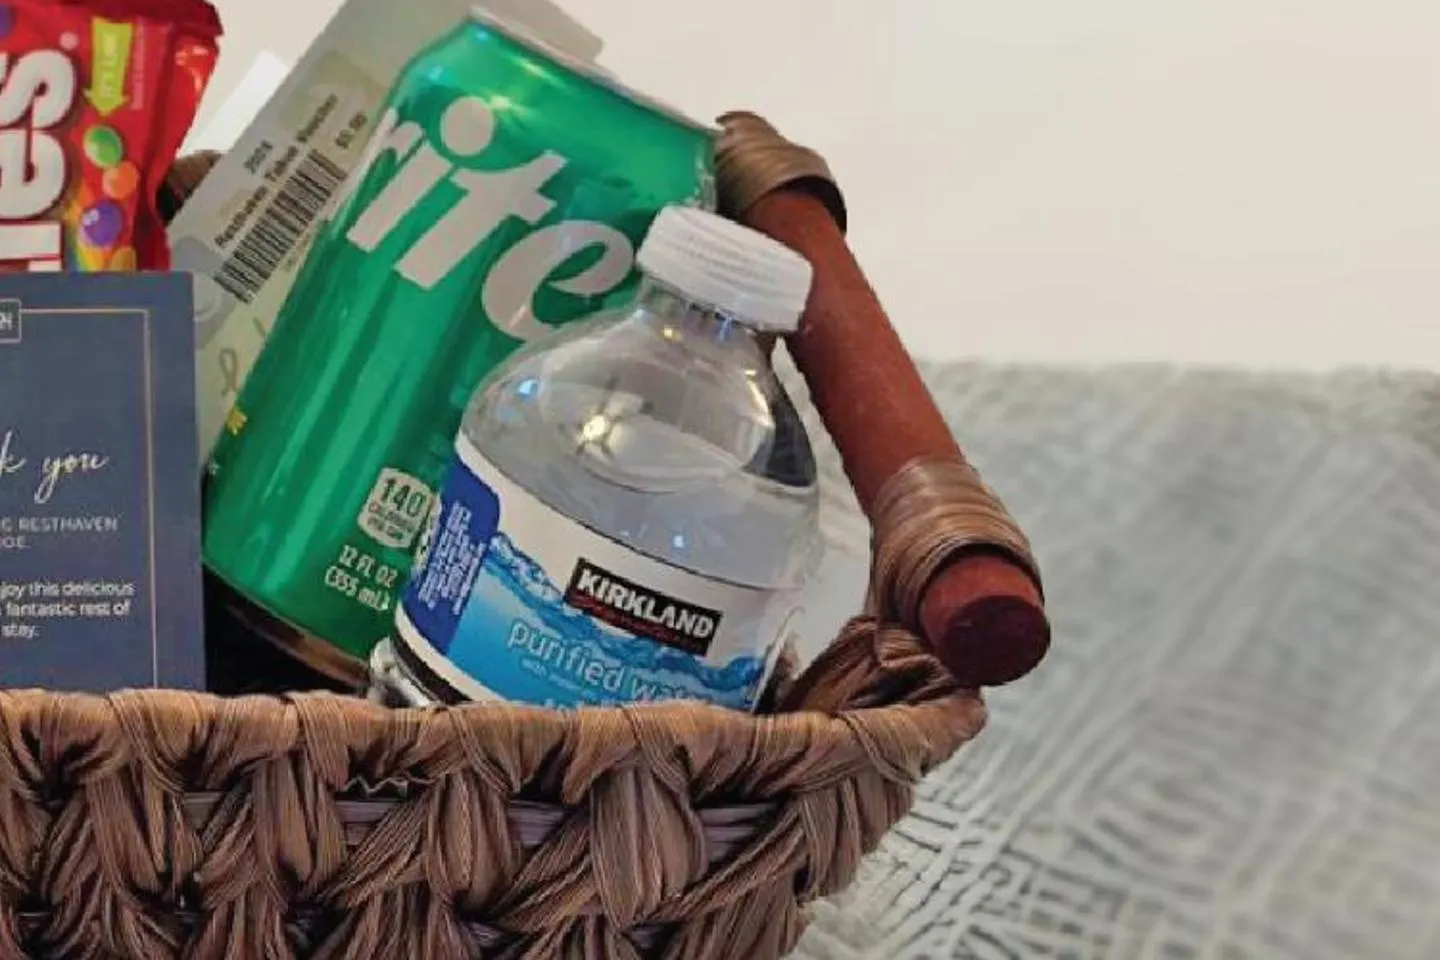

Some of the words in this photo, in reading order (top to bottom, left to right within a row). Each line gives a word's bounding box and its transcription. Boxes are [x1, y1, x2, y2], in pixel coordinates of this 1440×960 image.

[33, 451, 110, 505] you
[381, 477, 425, 518] 140
[17, 515, 120, 533] RESTHAVEN
[28, 581, 61, 597] this
[62, 580, 135, 597] delicious
[576, 568, 714, 639] KIRKLAND
[4, 600, 77, 618] fantastic
[79, 601, 111, 617] rest
[112, 599, 132, 616] of
[1, 623, 40, 639] stay.
[507, 620, 626, 692] purified
